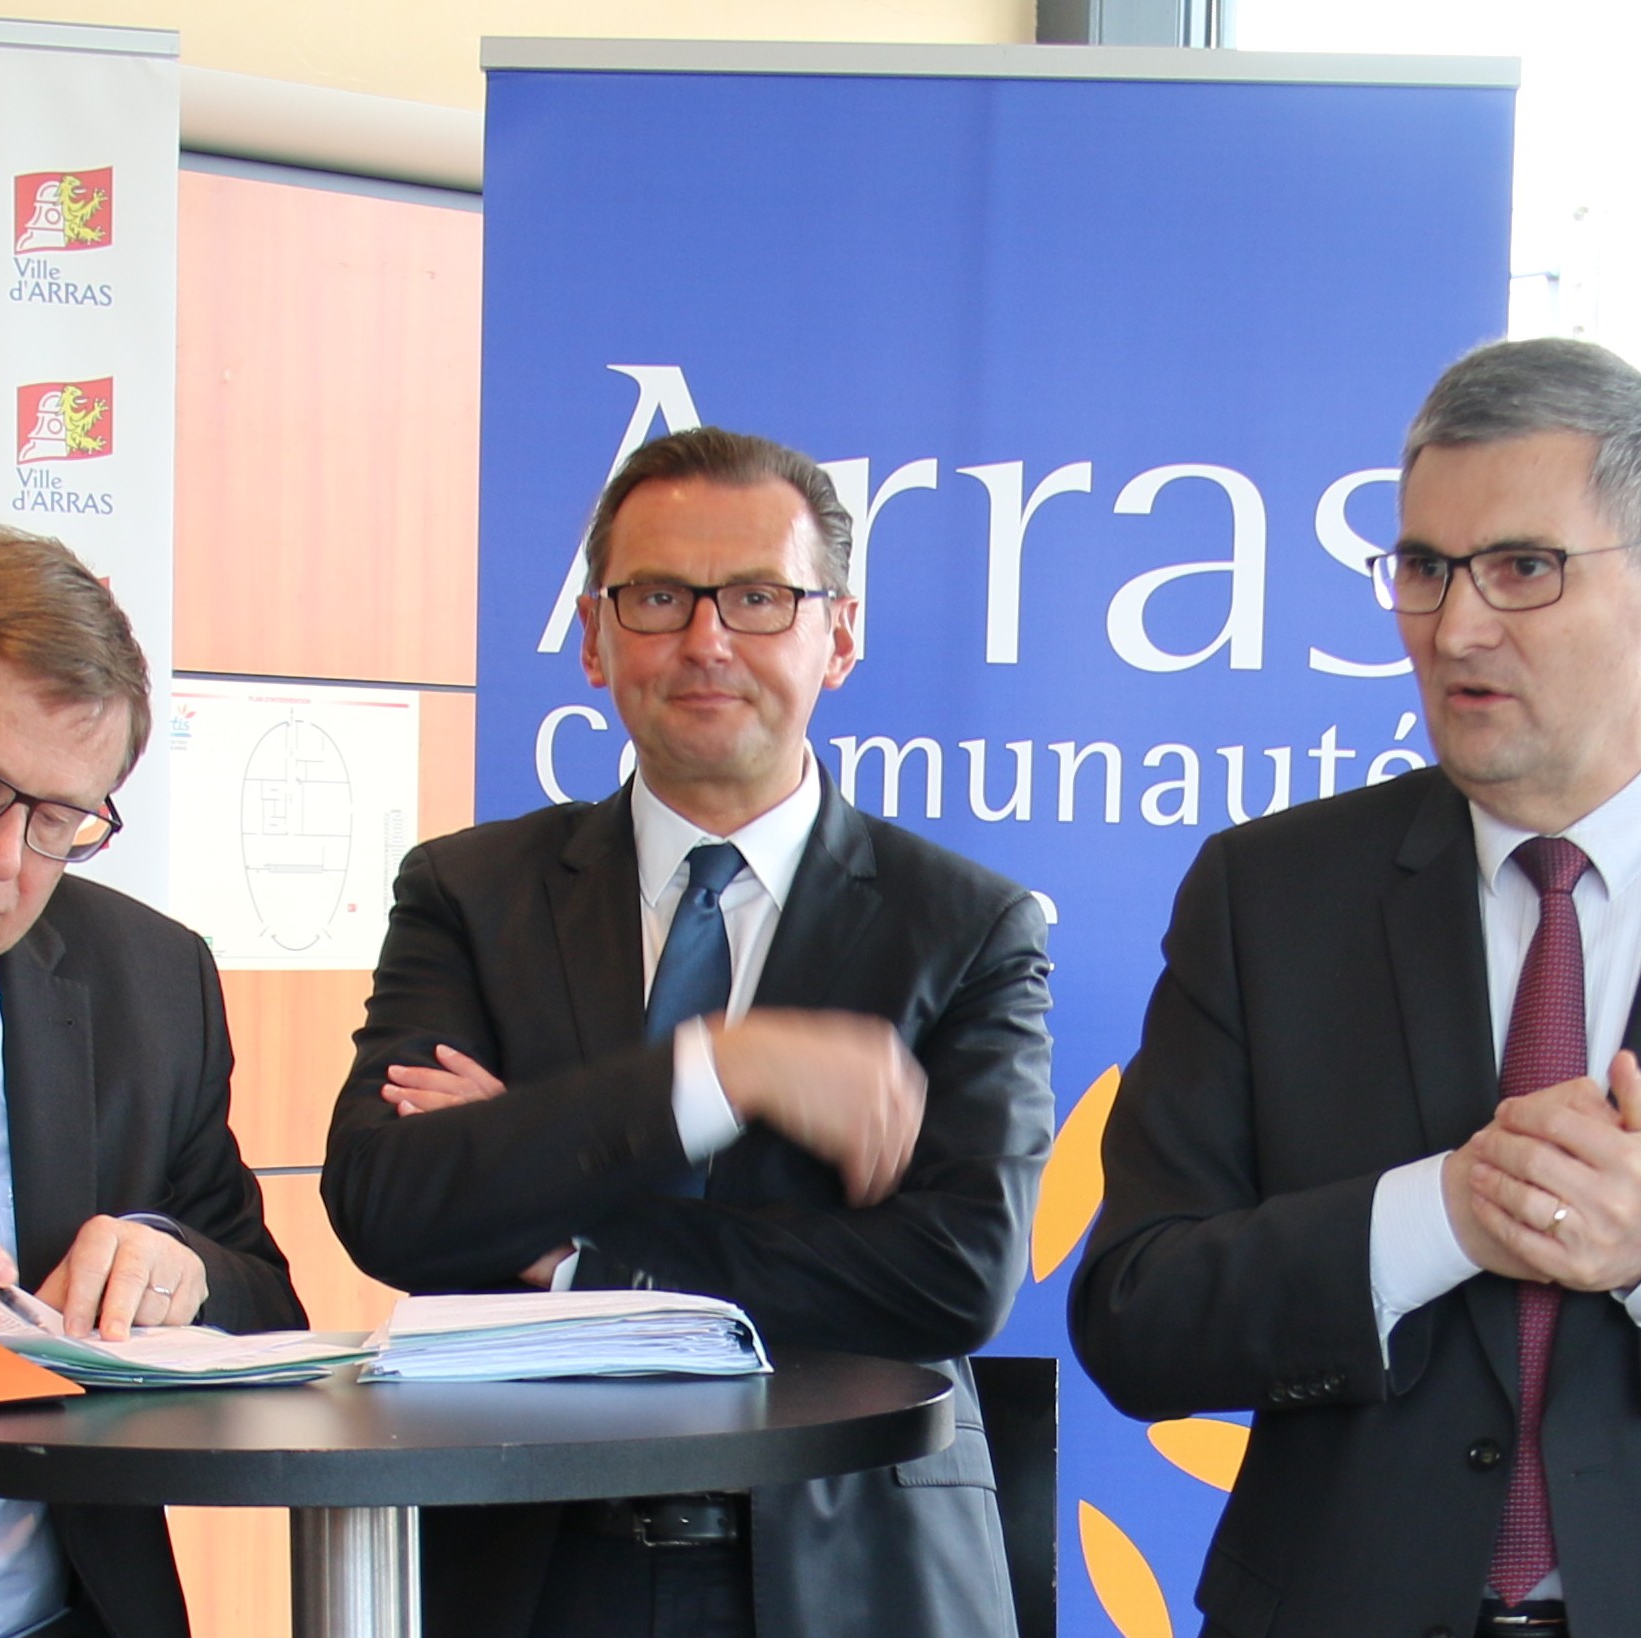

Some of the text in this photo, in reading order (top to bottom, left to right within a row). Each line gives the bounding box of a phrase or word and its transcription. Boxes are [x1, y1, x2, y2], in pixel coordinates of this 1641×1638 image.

[14, 258, 60, 280] Ville
[9, 281, 113, 306] d'ARRAS
[16, 468, 62, 490] Ville
[12, 490, 114, 515] d'ARRAS
[535, 704, 1427, 822] Cmunauté
